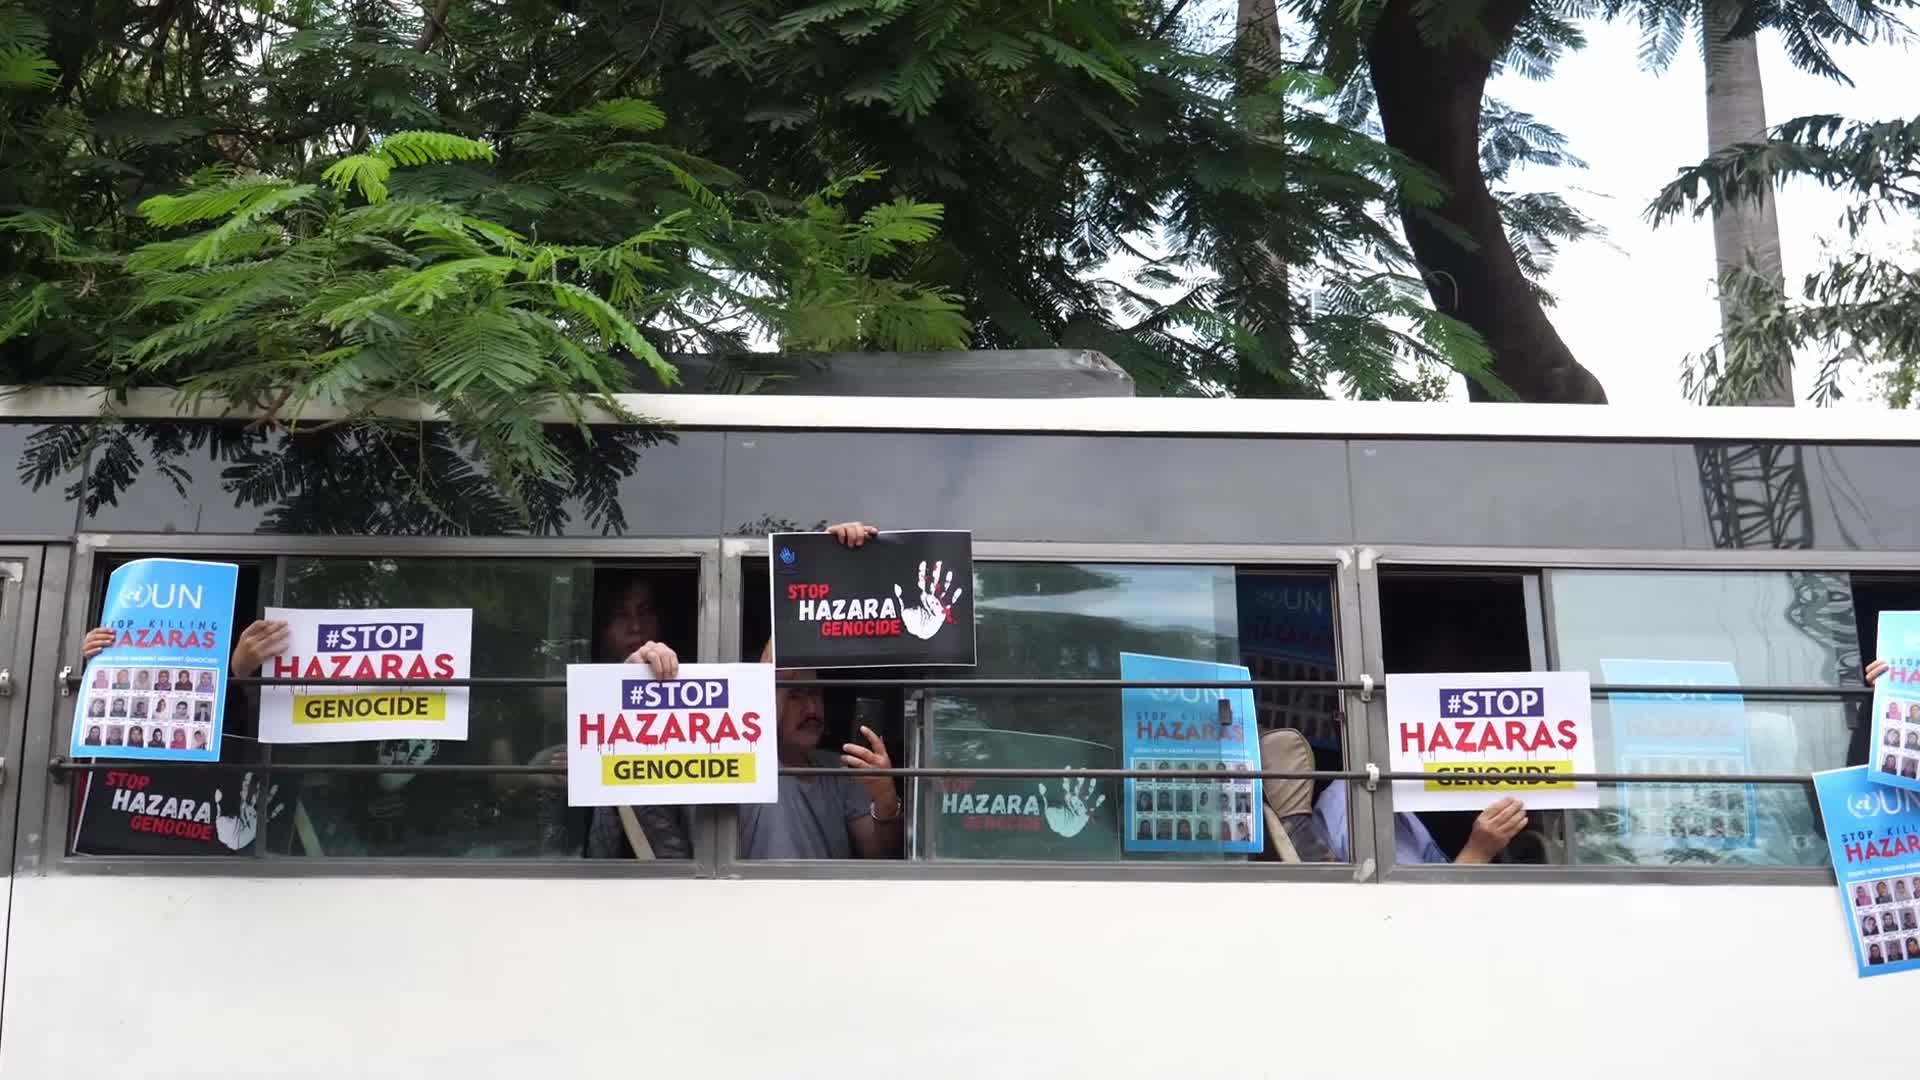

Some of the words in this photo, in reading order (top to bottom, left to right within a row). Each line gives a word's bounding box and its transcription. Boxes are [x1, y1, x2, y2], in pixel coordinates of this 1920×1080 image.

[787, 584, 831, 600] STOP
[799, 597, 897, 621] HAZARA
[148, 619, 218, 632] KILLING
[325, 625, 419, 650] #STOP
[820, 620, 901, 637] GENOCIDE
[273, 653, 455, 681] HAZARAS
[630, 682, 723, 707] #STOP
[1447, 690, 1539, 715] #STOP
[305, 697, 428, 719] GENOCIDE
[579, 711, 762, 748] HAZARAS
[1400, 720, 1578, 754] HAZARAS
[105, 770, 151, 789] STOP
[613, 758, 740, 779] GENOCIDE
[112, 788, 211, 825] HAZARA
[941, 793, 1040, 816] HAZARA
[130, 815, 215, 841] GENOCIDE
[1841, 830, 1873, 843] STOP
